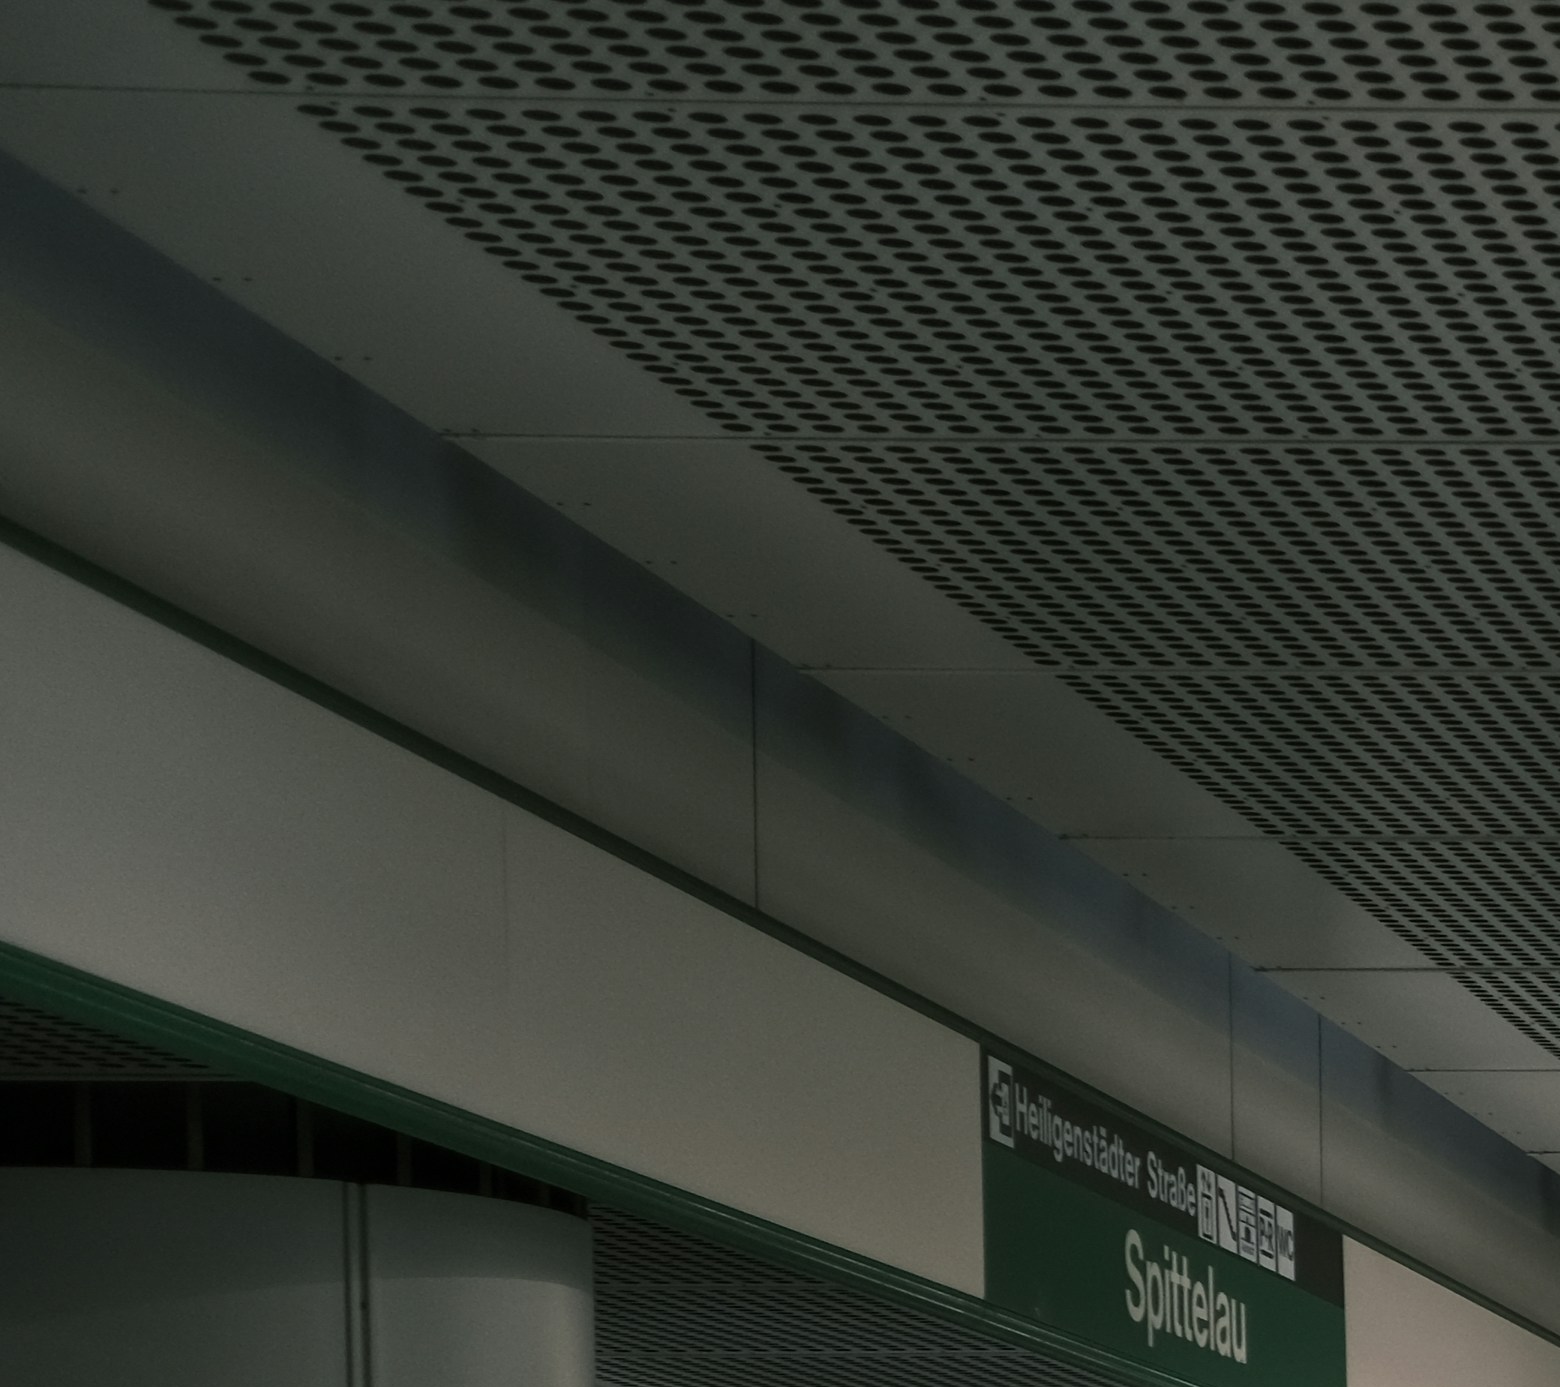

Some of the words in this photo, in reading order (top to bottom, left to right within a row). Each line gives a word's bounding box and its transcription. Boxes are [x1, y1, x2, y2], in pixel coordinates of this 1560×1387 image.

[1014, 1082, 1141, 1190] Heiligenstädter
[1146, 1150, 1197, 1218] Straße
[1124, 1228, 1248, 1364] Spittelau
[1276, 1224, 1294, 1261] WC
